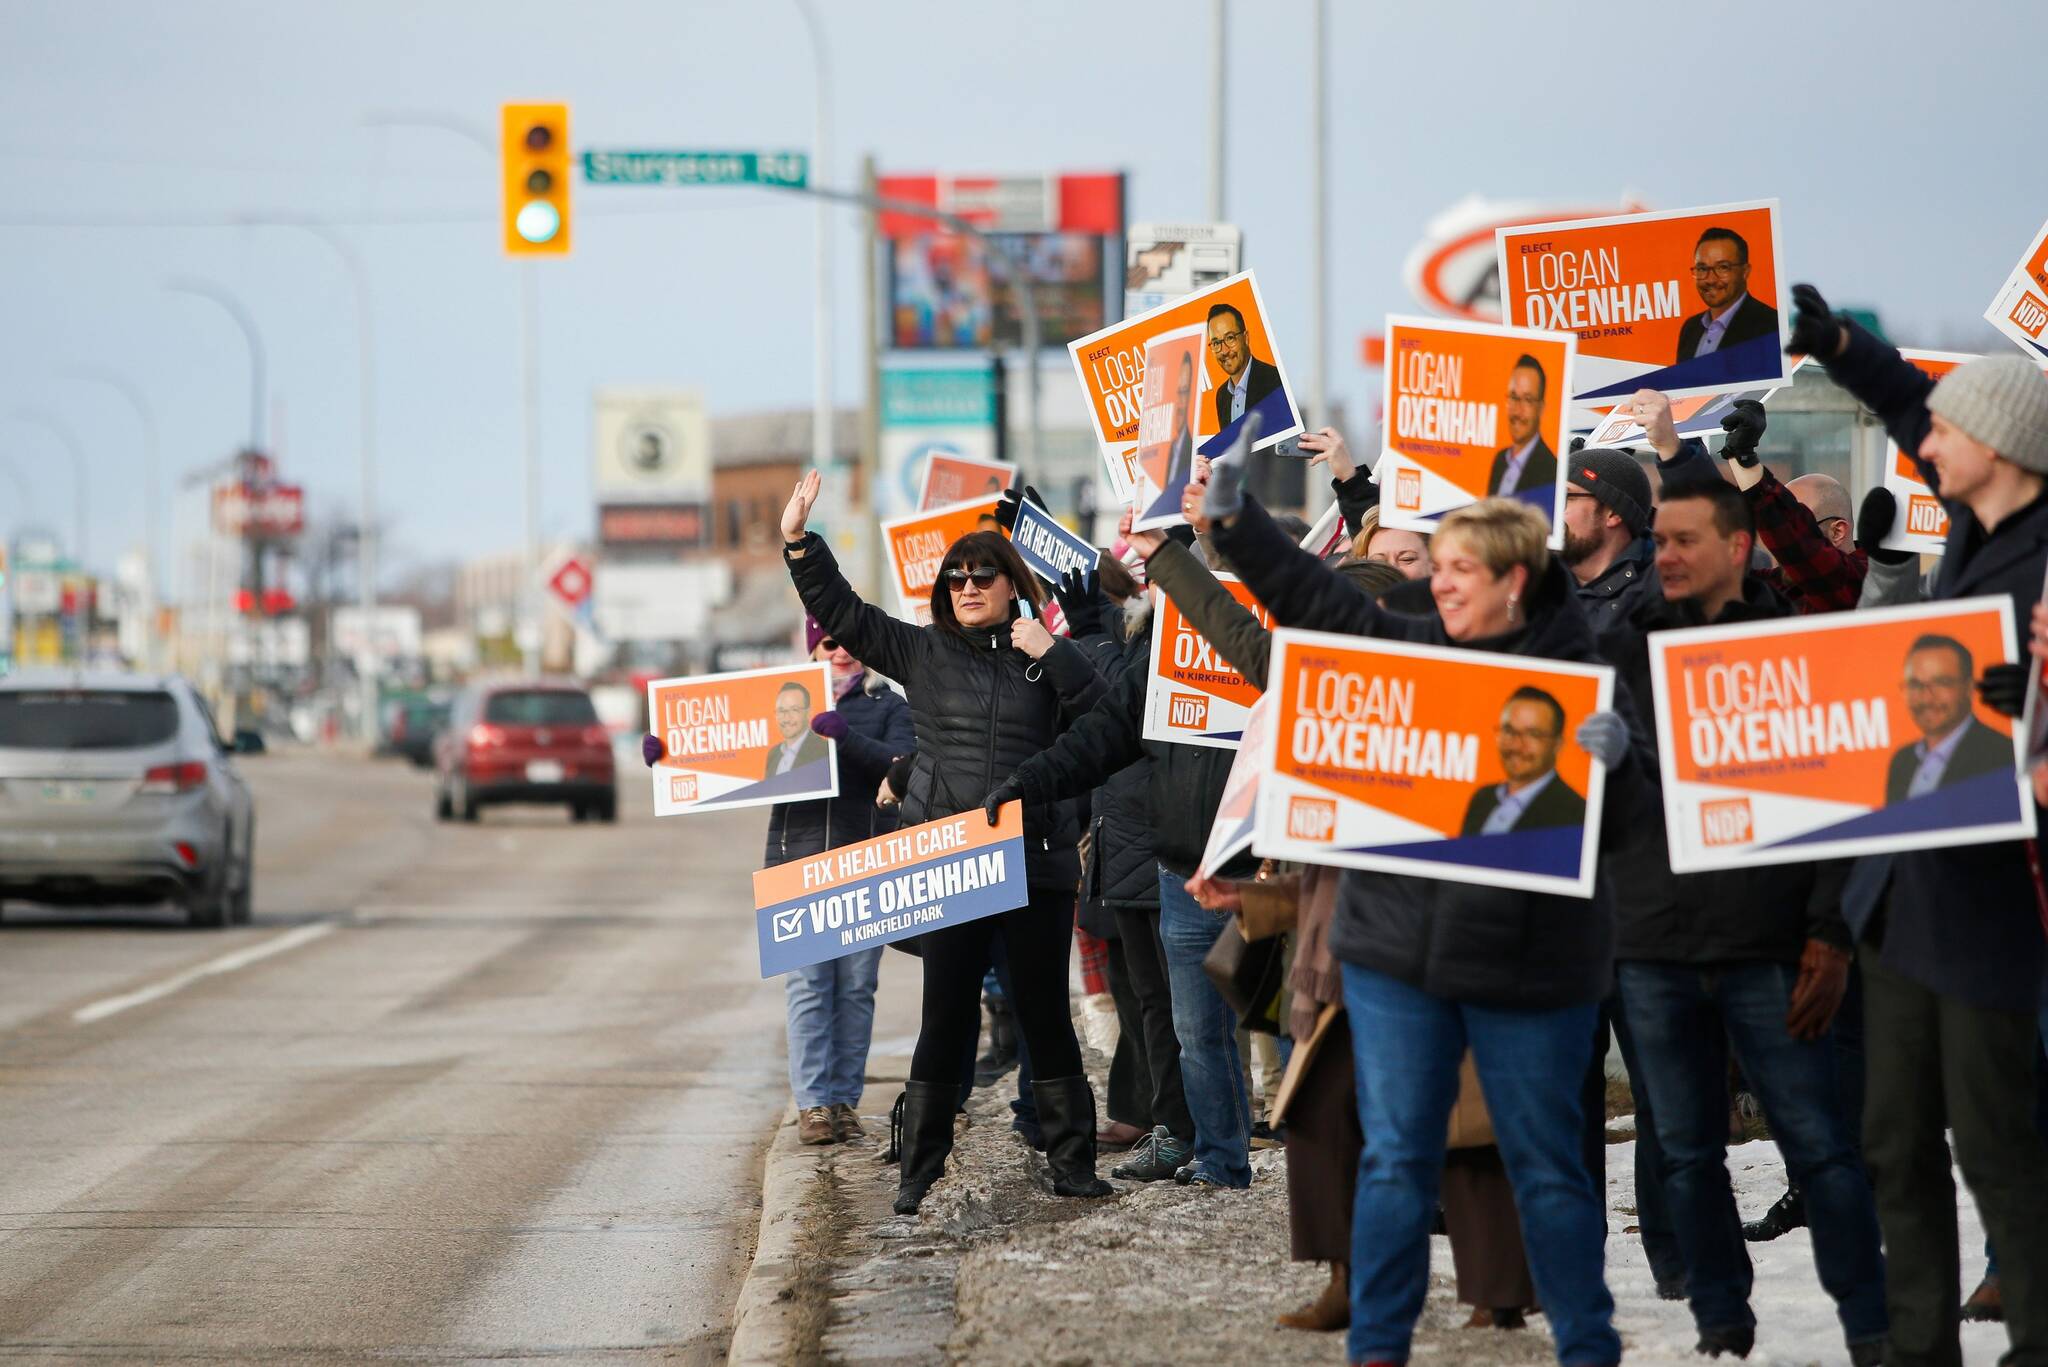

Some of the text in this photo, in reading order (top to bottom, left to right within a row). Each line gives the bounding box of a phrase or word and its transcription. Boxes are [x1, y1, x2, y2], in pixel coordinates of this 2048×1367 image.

[591, 153, 804, 187] Sturgeon Rd
[1519, 243, 1552, 254] ELECT
[1523, 246, 1620, 293] LOGAN
[1525, 279, 1681, 331] OXENHAM
[2013, 299, 2047, 332] NDP
[1604, 326, 1633, 338] PARK
[1088, 346, 1111, 362] ELECT
[1398, 350, 1462, 398] LOGAN
[1396, 393, 1498, 448] OXENHAM
[1018, 514, 1037, 549] FIX
[1910, 504, 1947, 534] NDP
[896, 529, 945, 565] LOGAN
[1174, 670, 1184, 680] IN
[1187, 671, 1240, 686] KIRKFIELD
[1682, 656, 1811, 718] LOGAN
[665, 695, 730, 728] LOGAN
[1171, 702, 1206, 727] NDP
[1296, 667, 1415, 727] LOGAN
[666, 717, 769, 757] OXENHAM
[1291, 717, 1481, 783] OXENHAM
[1689, 699, 1889, 766] OXENHAM
[672, 780, 697, 800] NDP
[1290, 804, 1334, 838] NDP
[801, 820, 967, 889] FIX HEALTH CARE
[808, 850, 1006, 934] VOTE OXENHAM
[841, 904, 944, 946] IN KIRKFIELD PARK
